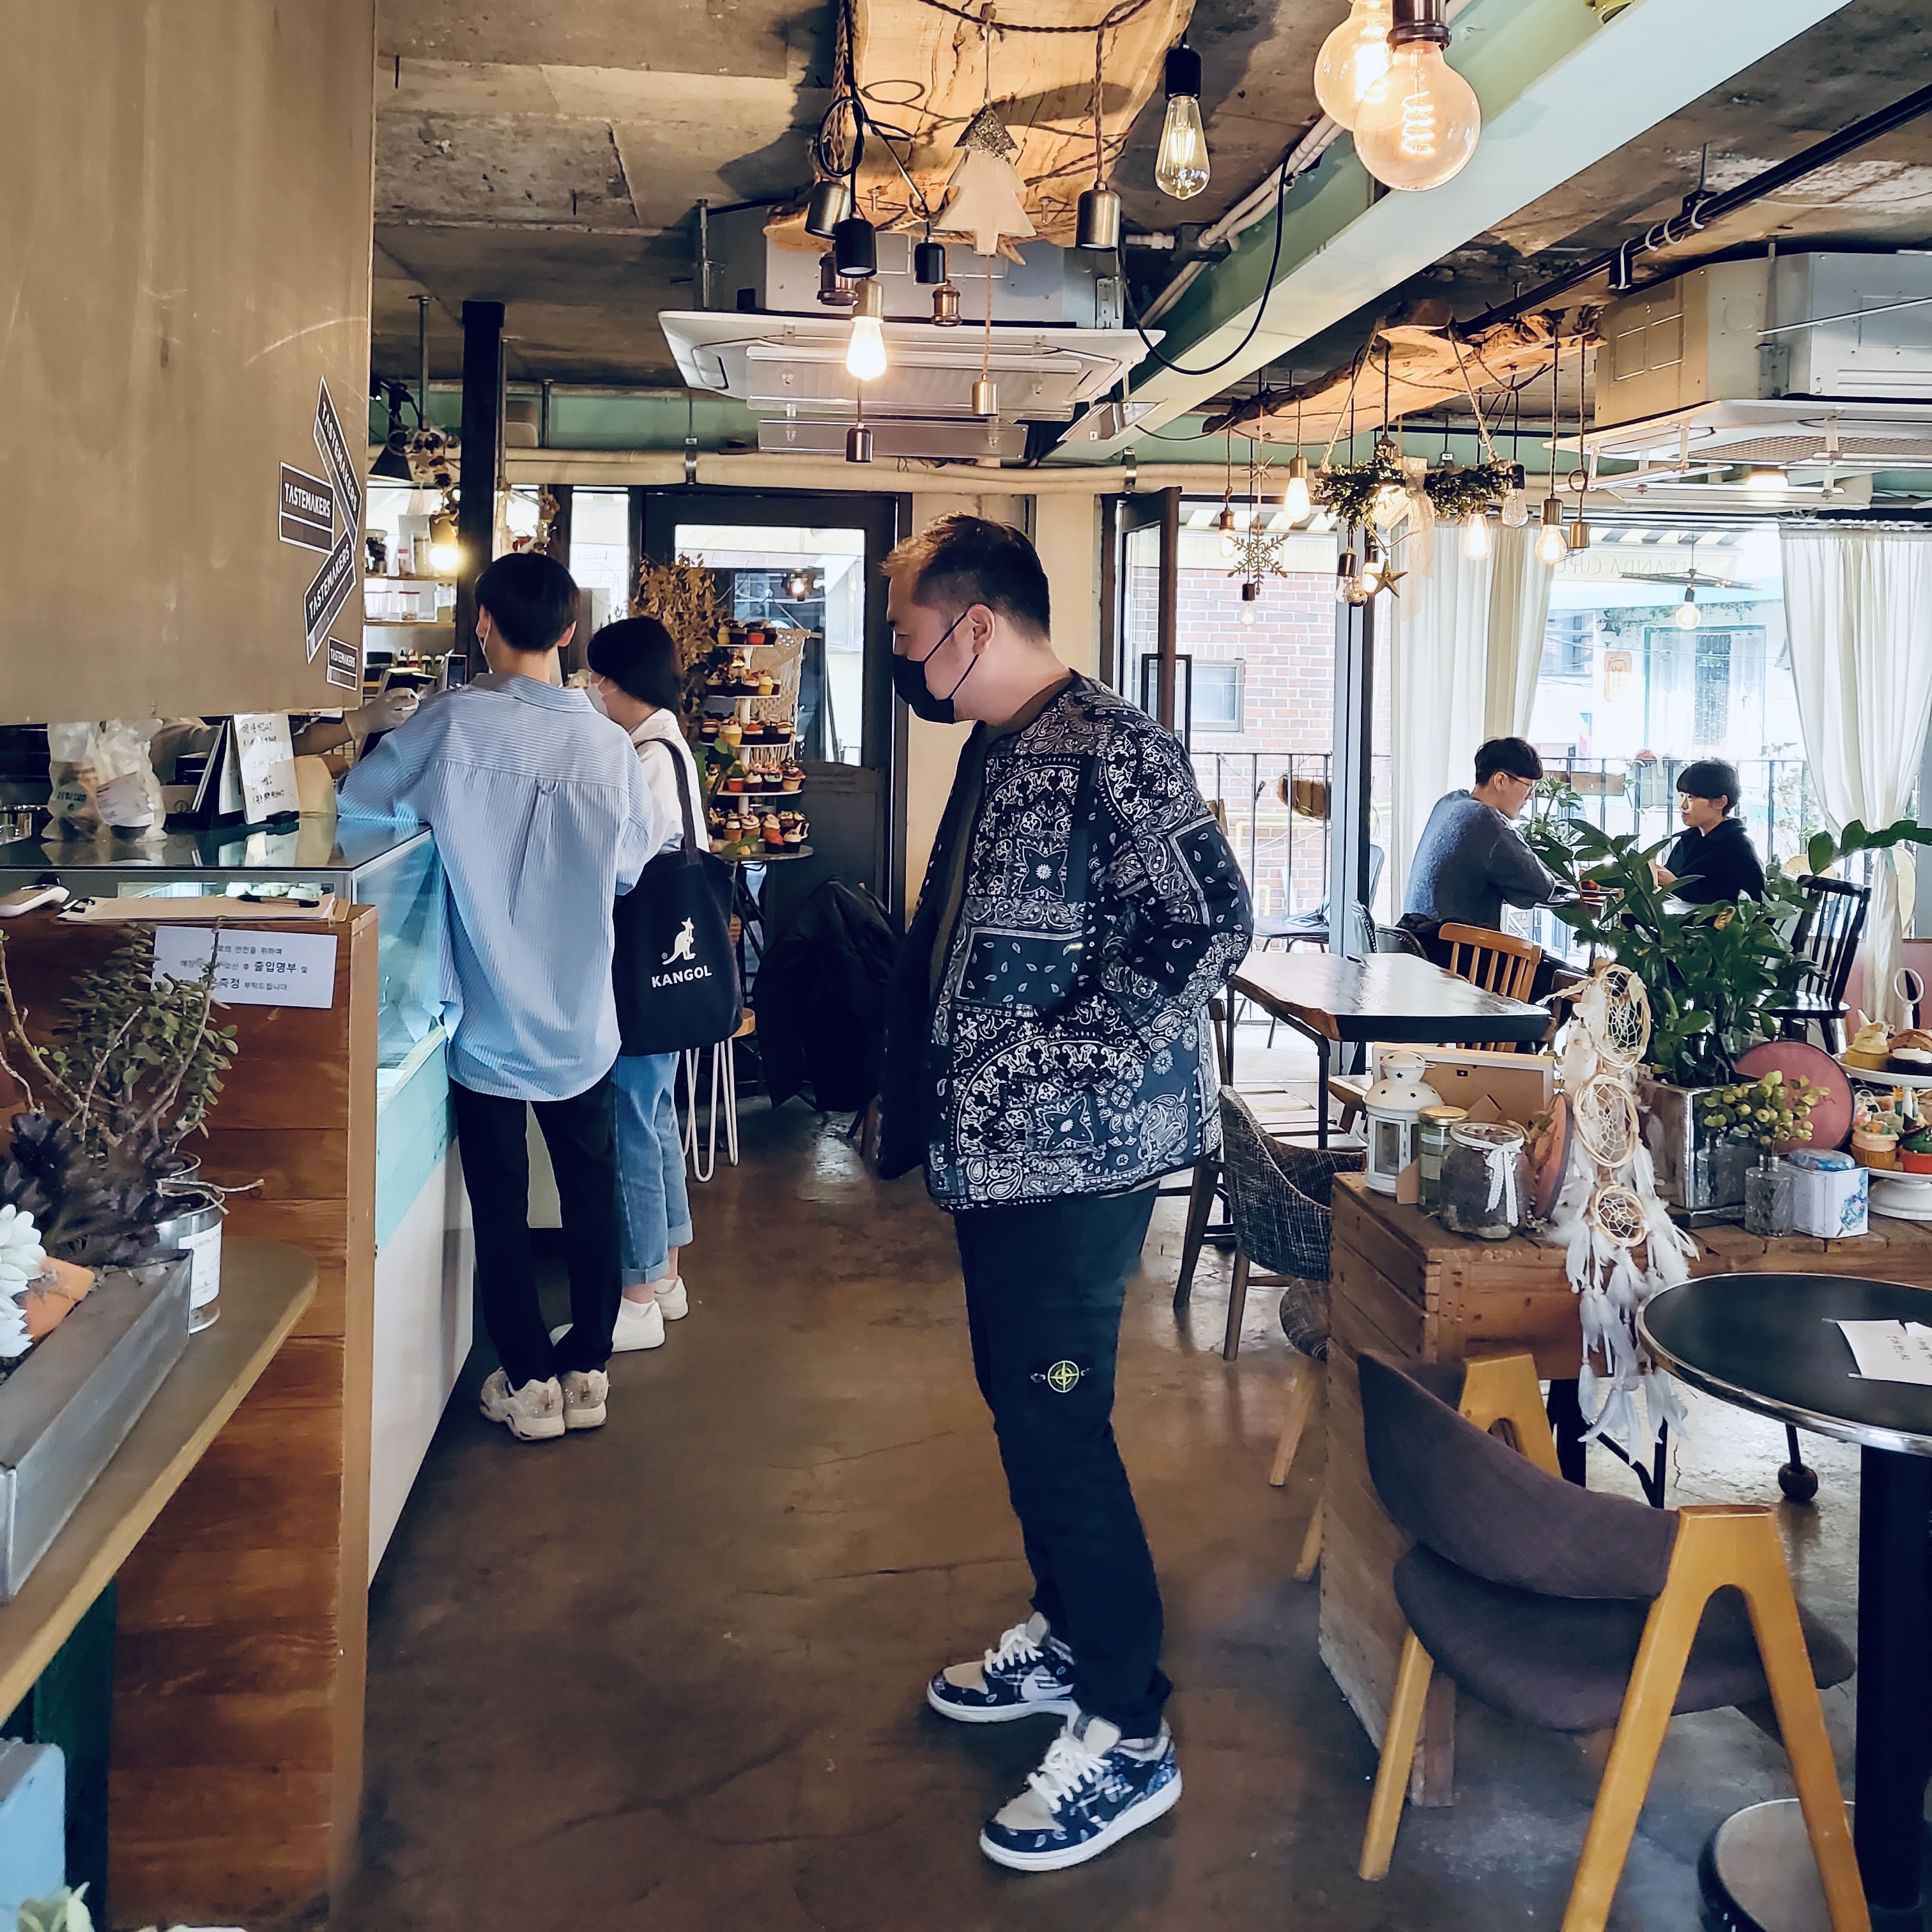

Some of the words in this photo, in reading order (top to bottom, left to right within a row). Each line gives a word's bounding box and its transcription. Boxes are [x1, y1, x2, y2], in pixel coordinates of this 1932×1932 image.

[321, 401, 358, 512] TASTEMAKERS
[284, 482, 331, 519] TASTEMAKERS
[309, 543, 351, 620] TASTEMAKERS
[330, 648, 356, 668] TASTEMAKERS
[254, 962, 296, 974] 출입명부
[651, 965, 712, 988] KANGOL
